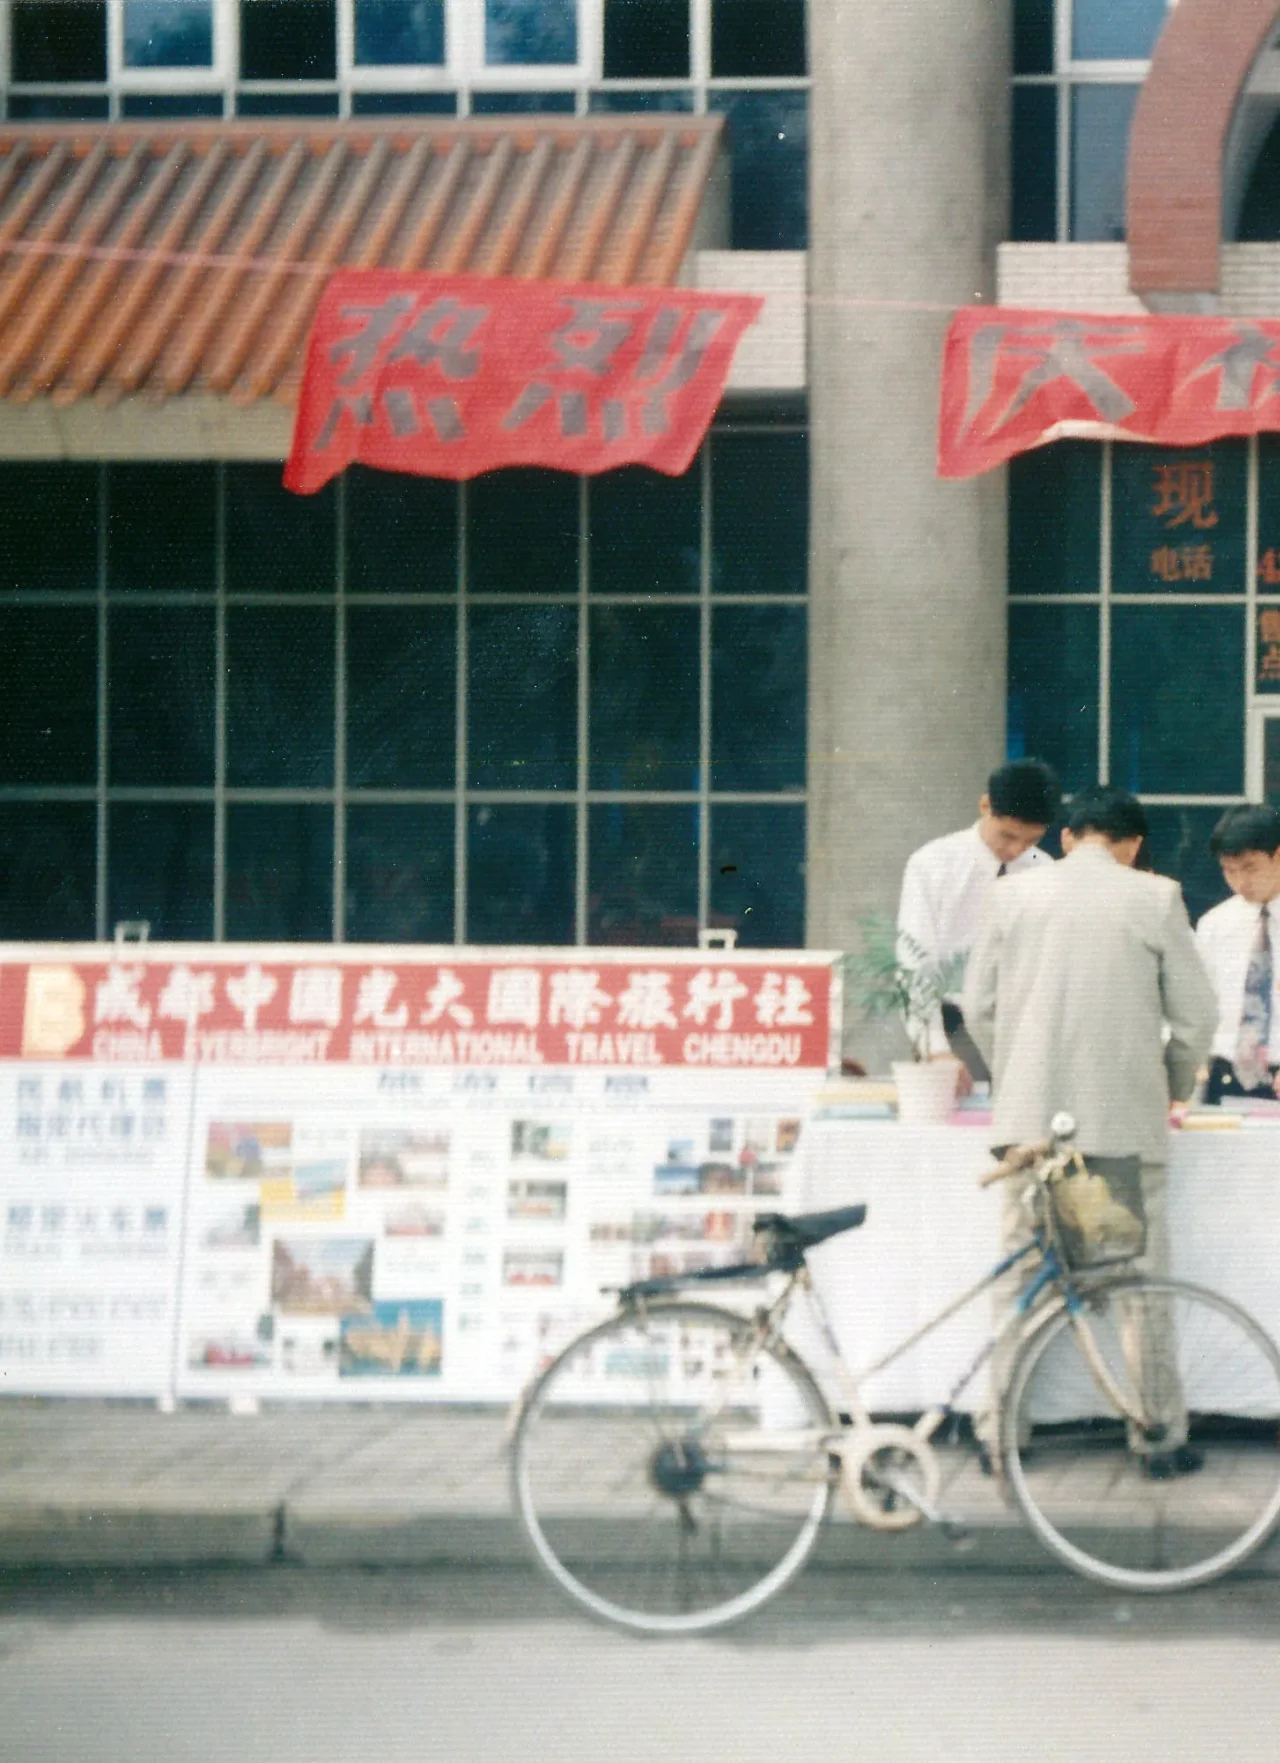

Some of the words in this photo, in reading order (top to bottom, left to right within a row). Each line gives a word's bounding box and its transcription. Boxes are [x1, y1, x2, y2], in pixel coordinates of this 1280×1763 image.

[312, 291, 724, 451] 热烈
[1151, 545, 1213, 581] 电话
[350, 1030, 544, 1066] INTERNATIONAL
[564, 1031, 665, 1066] TRAVEL
[682, 1031, 802, 1067] CHENGDU
